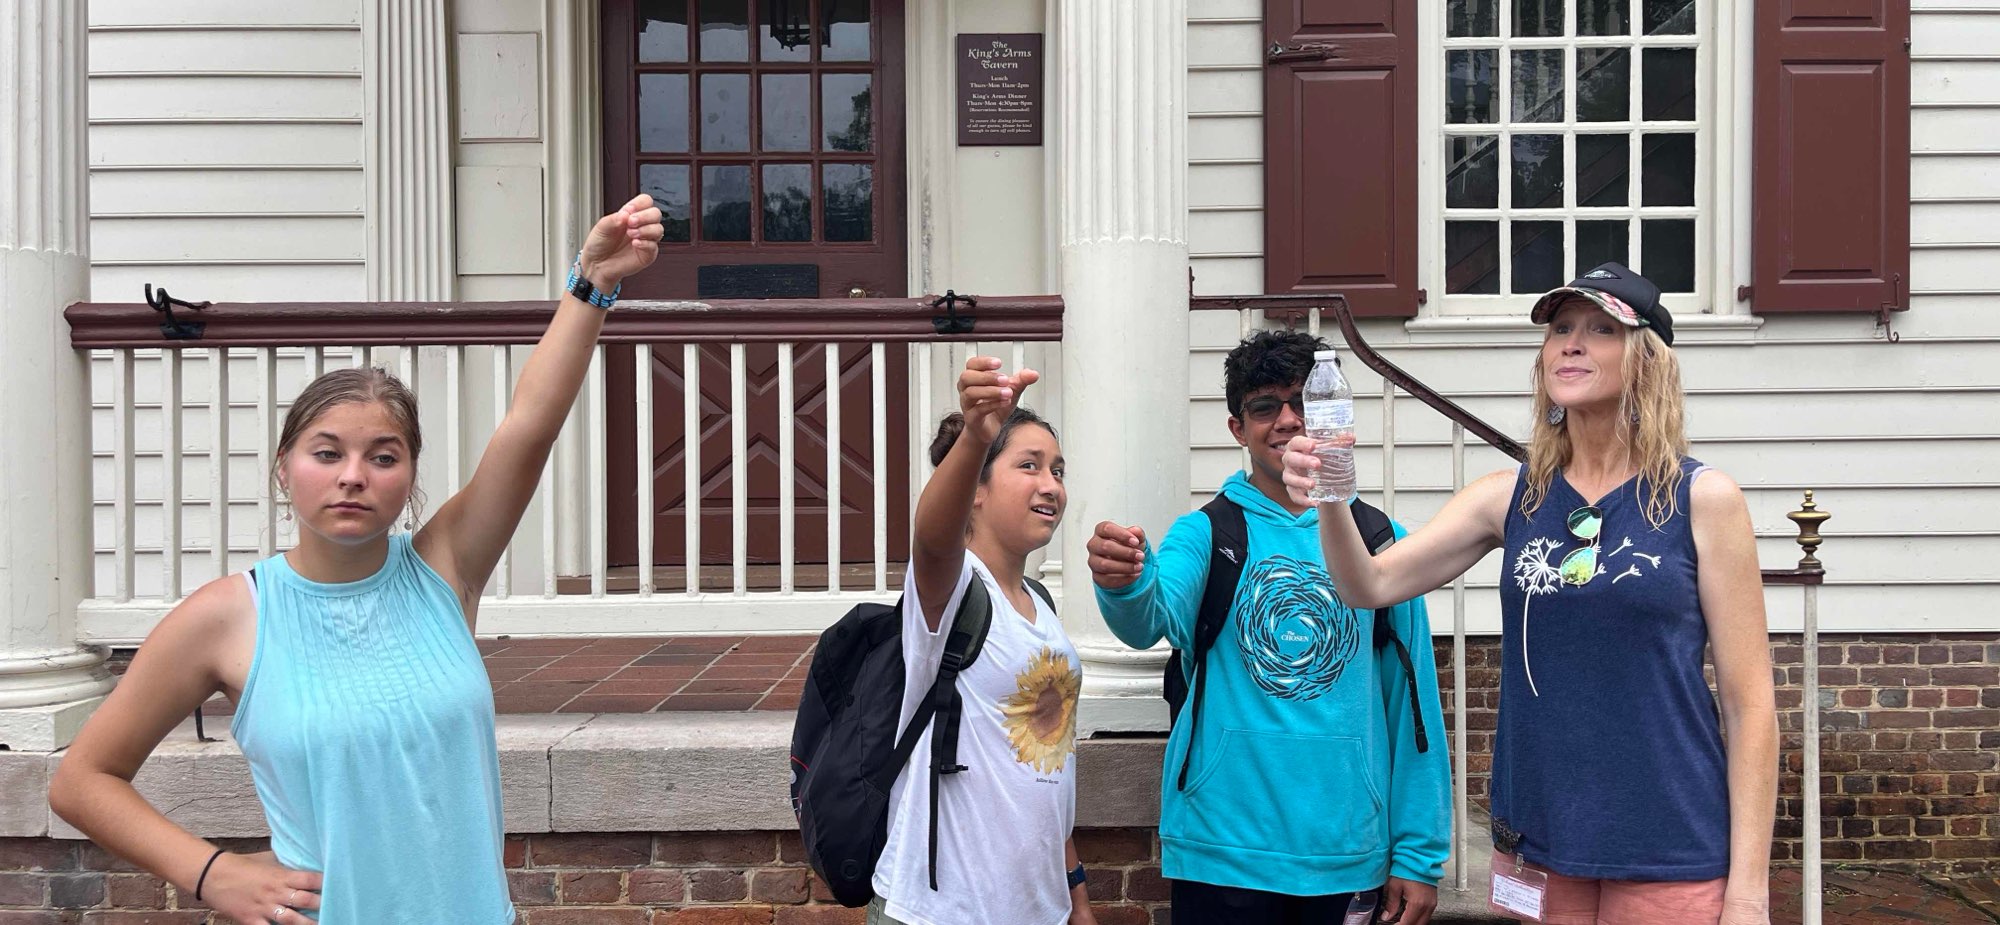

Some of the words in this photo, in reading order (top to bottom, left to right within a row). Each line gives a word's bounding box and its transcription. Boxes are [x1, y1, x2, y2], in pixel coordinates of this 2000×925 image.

[992, 40, 1008, 48] The
[968, 49, 999, 59] King's
[1002, 48, 1031, 57] Arms
[981, 60, 1018, 69] Tavern
[1281, 634, 1308, 642] CHOSEN
